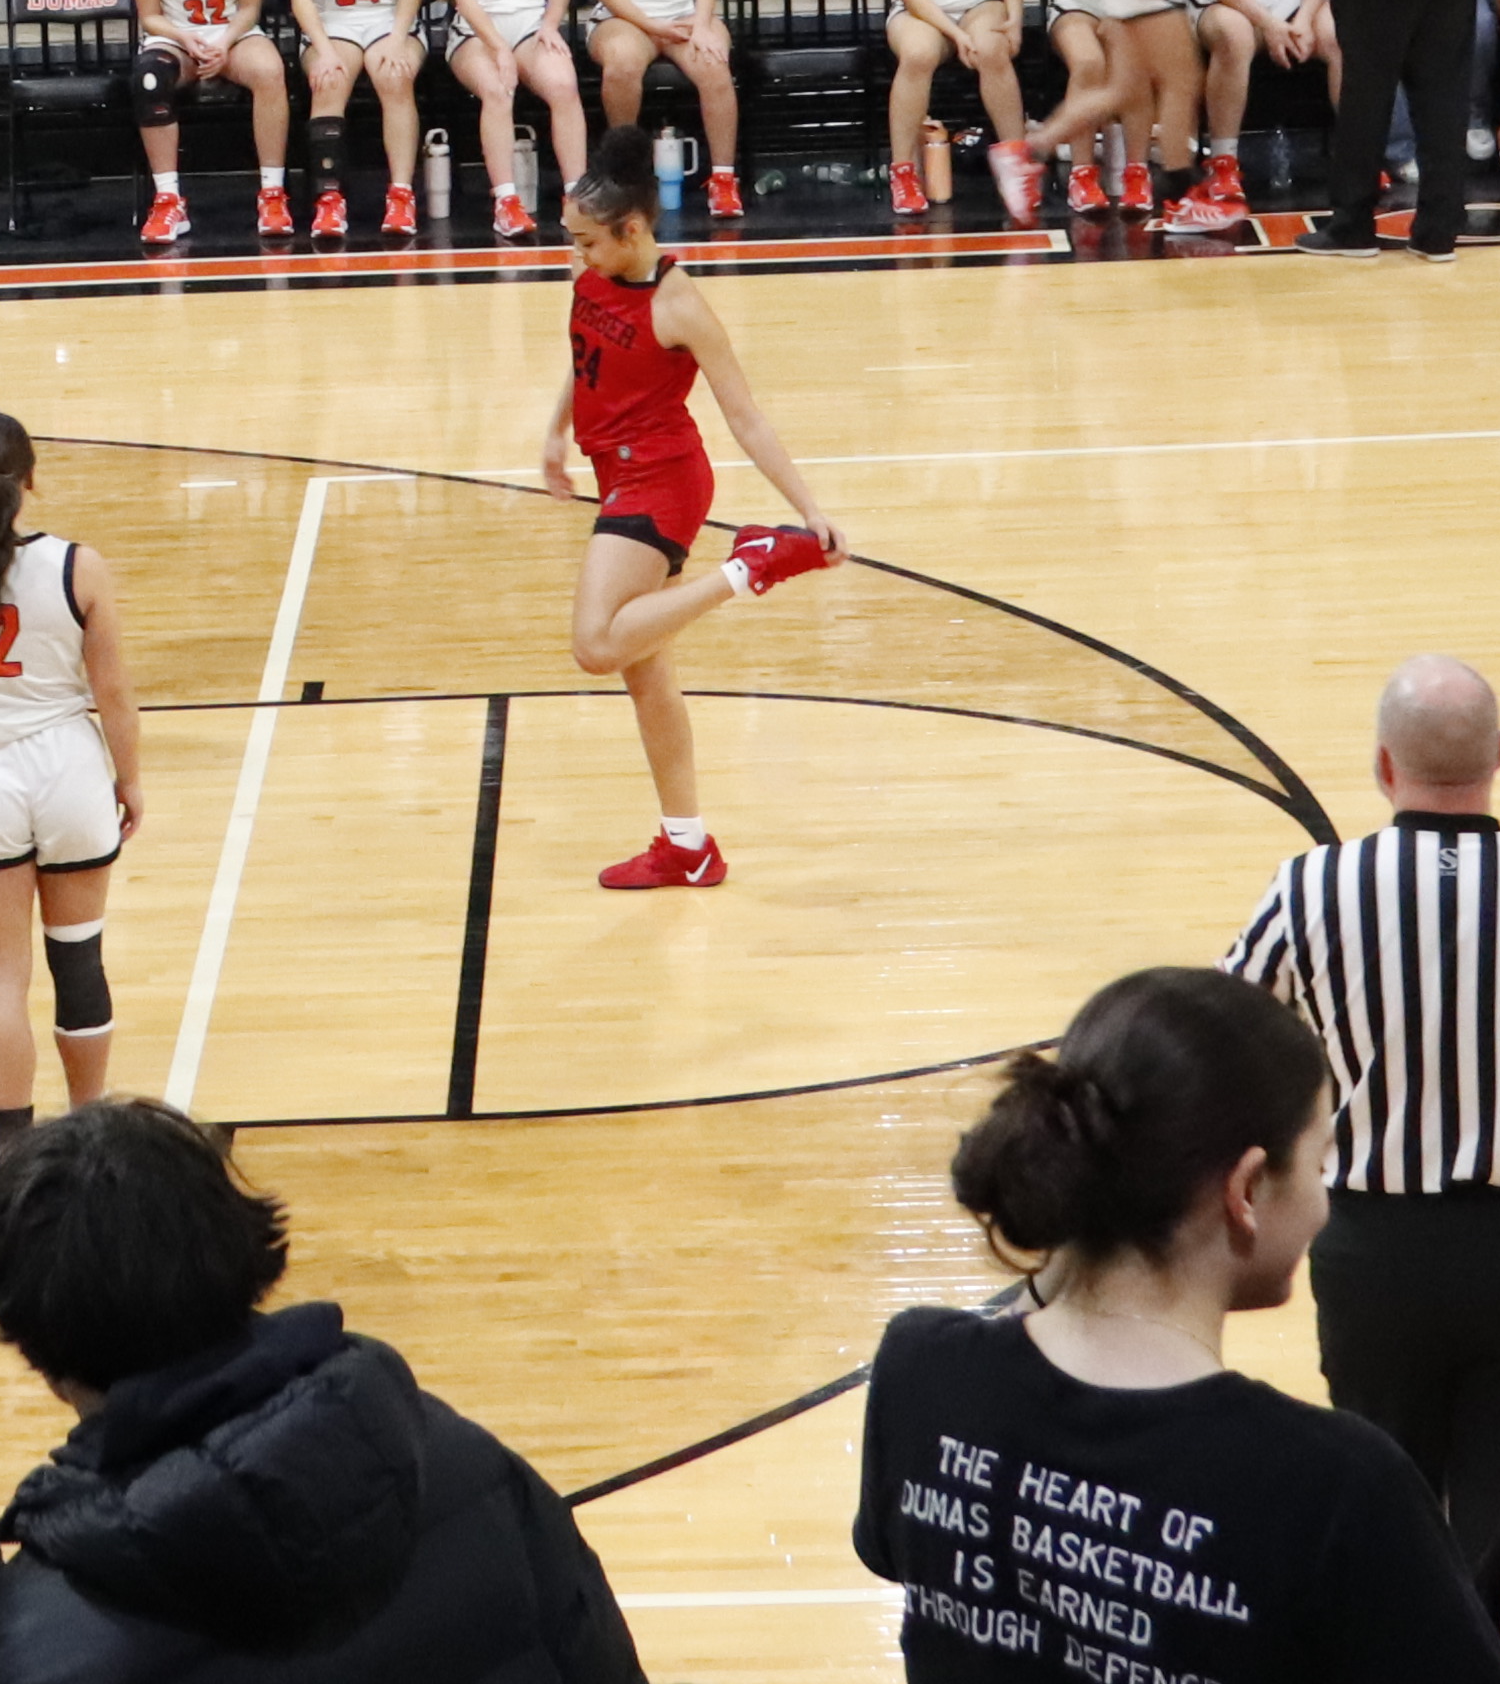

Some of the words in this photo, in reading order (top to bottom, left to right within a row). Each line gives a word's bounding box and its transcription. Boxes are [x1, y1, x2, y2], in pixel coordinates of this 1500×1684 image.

[937, 1434, 999, 1491] THE
[1018, 1460, 1141, 1533] HEART
[1161, 1508, 1214, 1553] OF
[901, 1479, 991, 1538] DUMAS
[1010, 1516, 1250, 1623] BASKETBALL
[953, 1550, 995, 1592] IS
[1017, 1568, 1152, 1648] EARNED
[903, 1580, 1042, 1654] THROUGH
[1063, 1634, 1224, 1684] DEFE
